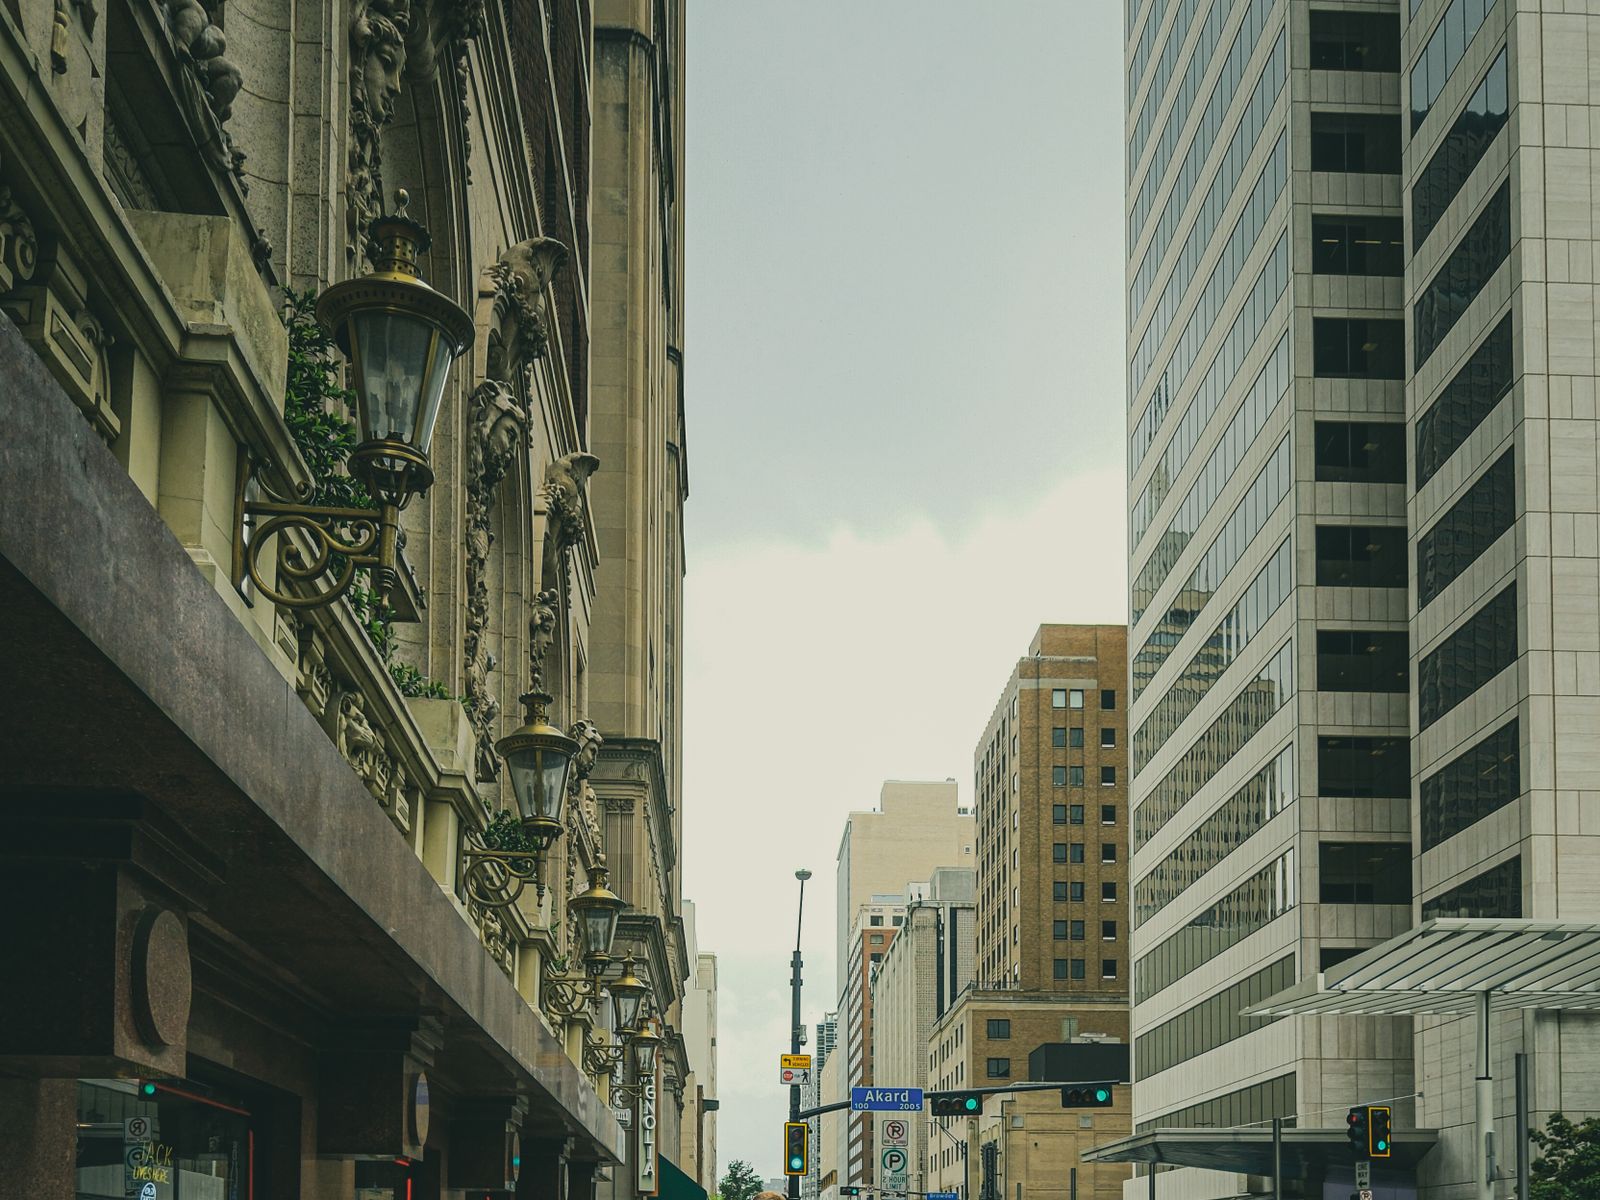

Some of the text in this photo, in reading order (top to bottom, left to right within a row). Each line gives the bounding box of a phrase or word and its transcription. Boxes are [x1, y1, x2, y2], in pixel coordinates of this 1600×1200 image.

[864, 1090, 909, 1103] Akard
[854, 1102, 869, 1110] 100
[138, 1141, 173, 1167] JACK
